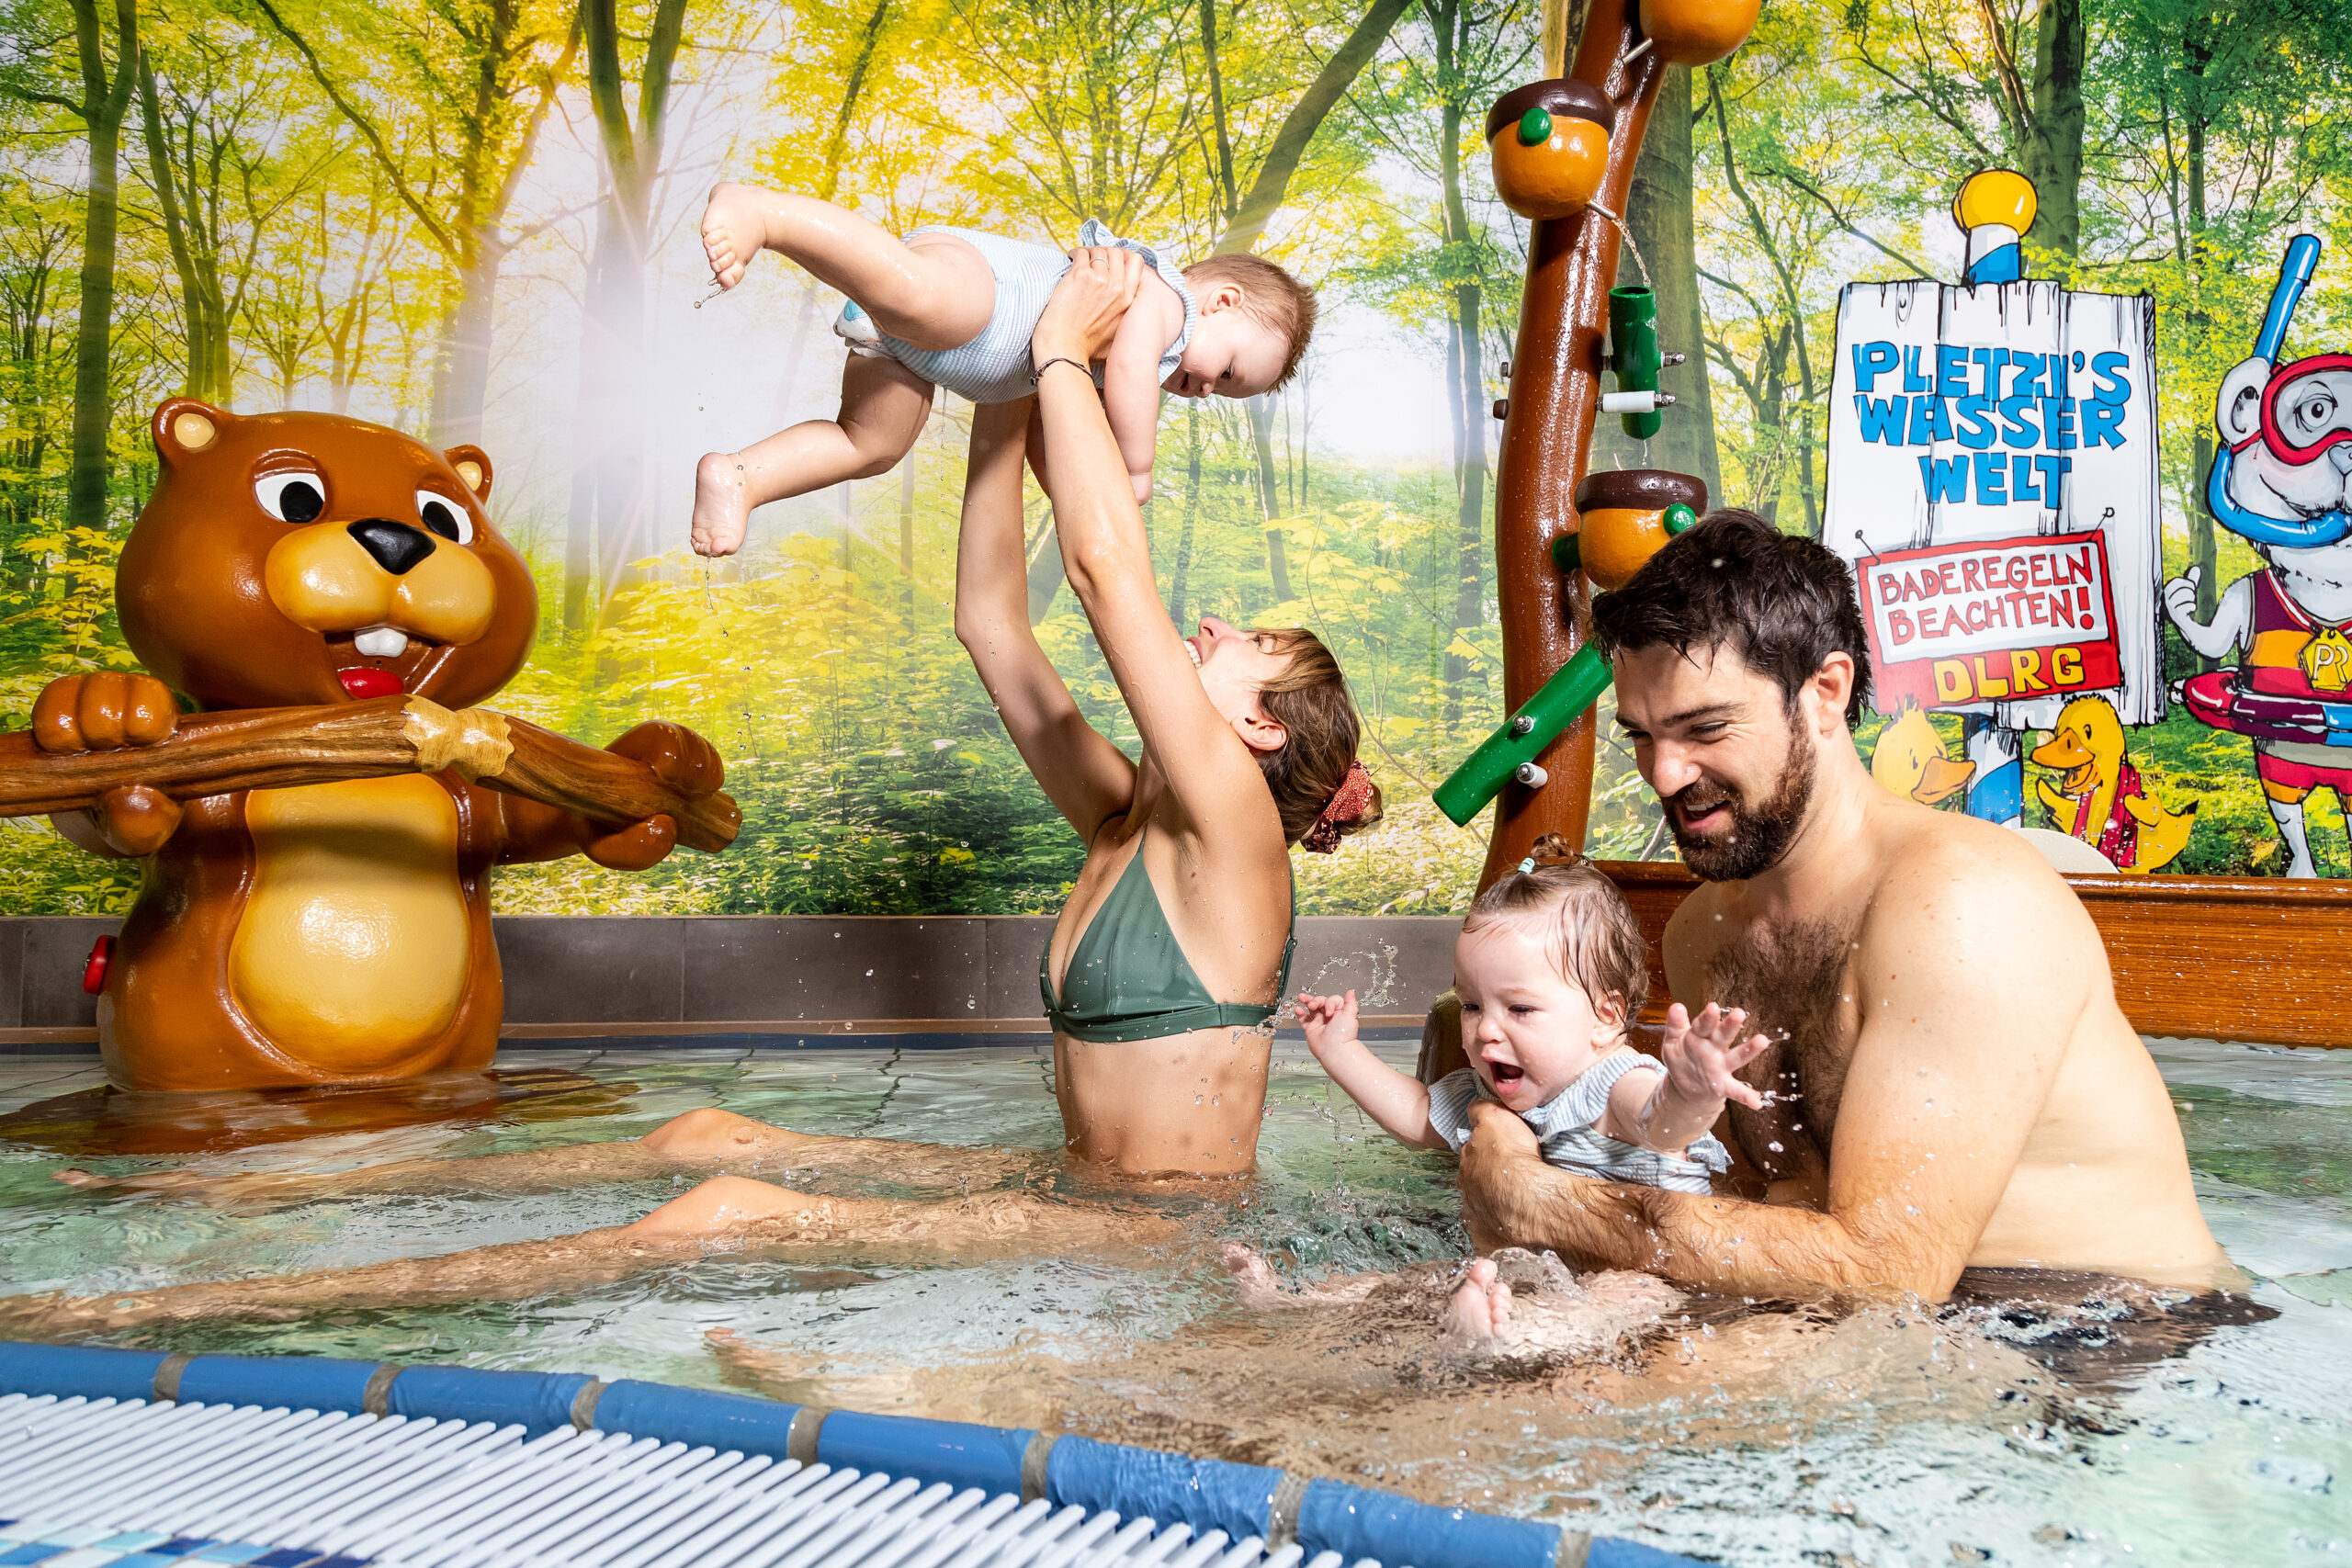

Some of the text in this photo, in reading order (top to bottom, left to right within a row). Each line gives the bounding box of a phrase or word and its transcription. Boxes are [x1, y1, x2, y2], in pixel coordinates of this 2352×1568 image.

[1851, 341, 2132, 406] PLETZI'S
[1853, 393, 2127, 450] WASSER
[1917, 452, 2072, 509] WELT
[1878, 546, 2093, 606] BADEREGELN
[1888, 586, 2095, 646] BEACHTEN!
[1933, 647, 2084, 703] DLRG
